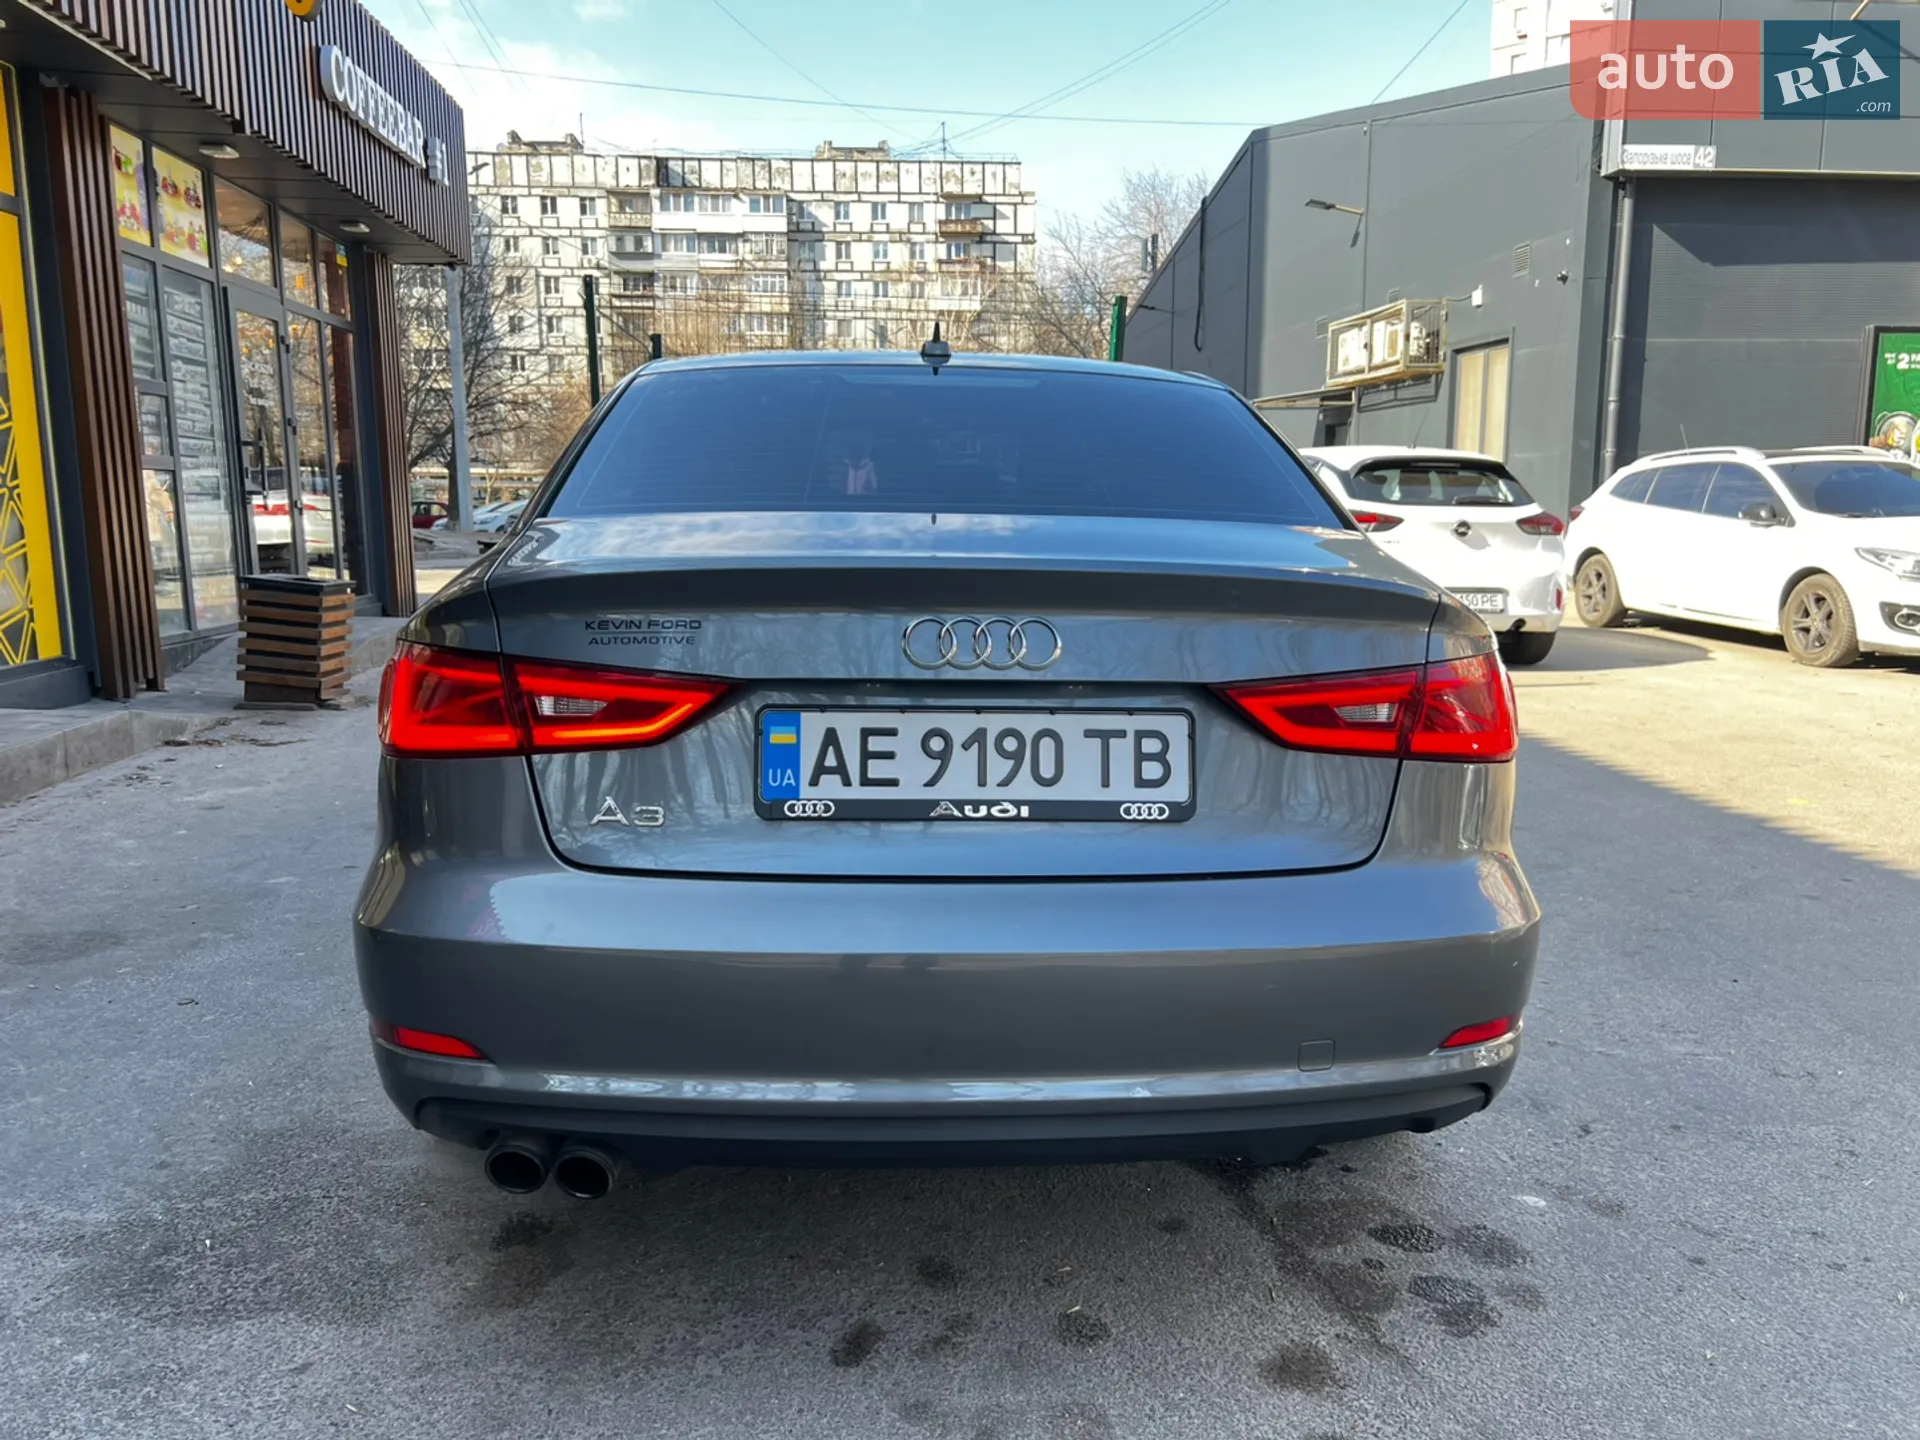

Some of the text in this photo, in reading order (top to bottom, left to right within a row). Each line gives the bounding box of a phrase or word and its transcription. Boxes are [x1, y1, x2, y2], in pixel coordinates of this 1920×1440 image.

[330, 45, 427, 169] COFFEEBAR
[1695, 146, 1714, 168] 42
[1896, 352, 1910, 370] 2
[1481, 594, 1499, 607] PE
[585, 620, 702, 630] KEVIN FORD
[588, 636, 697, 646] AUTOMOTIVE
[808, 727, 1172, 789] AE 9190 TB
[768, 768, 796, 787] UA
[589, 796, 665, 827] A3
